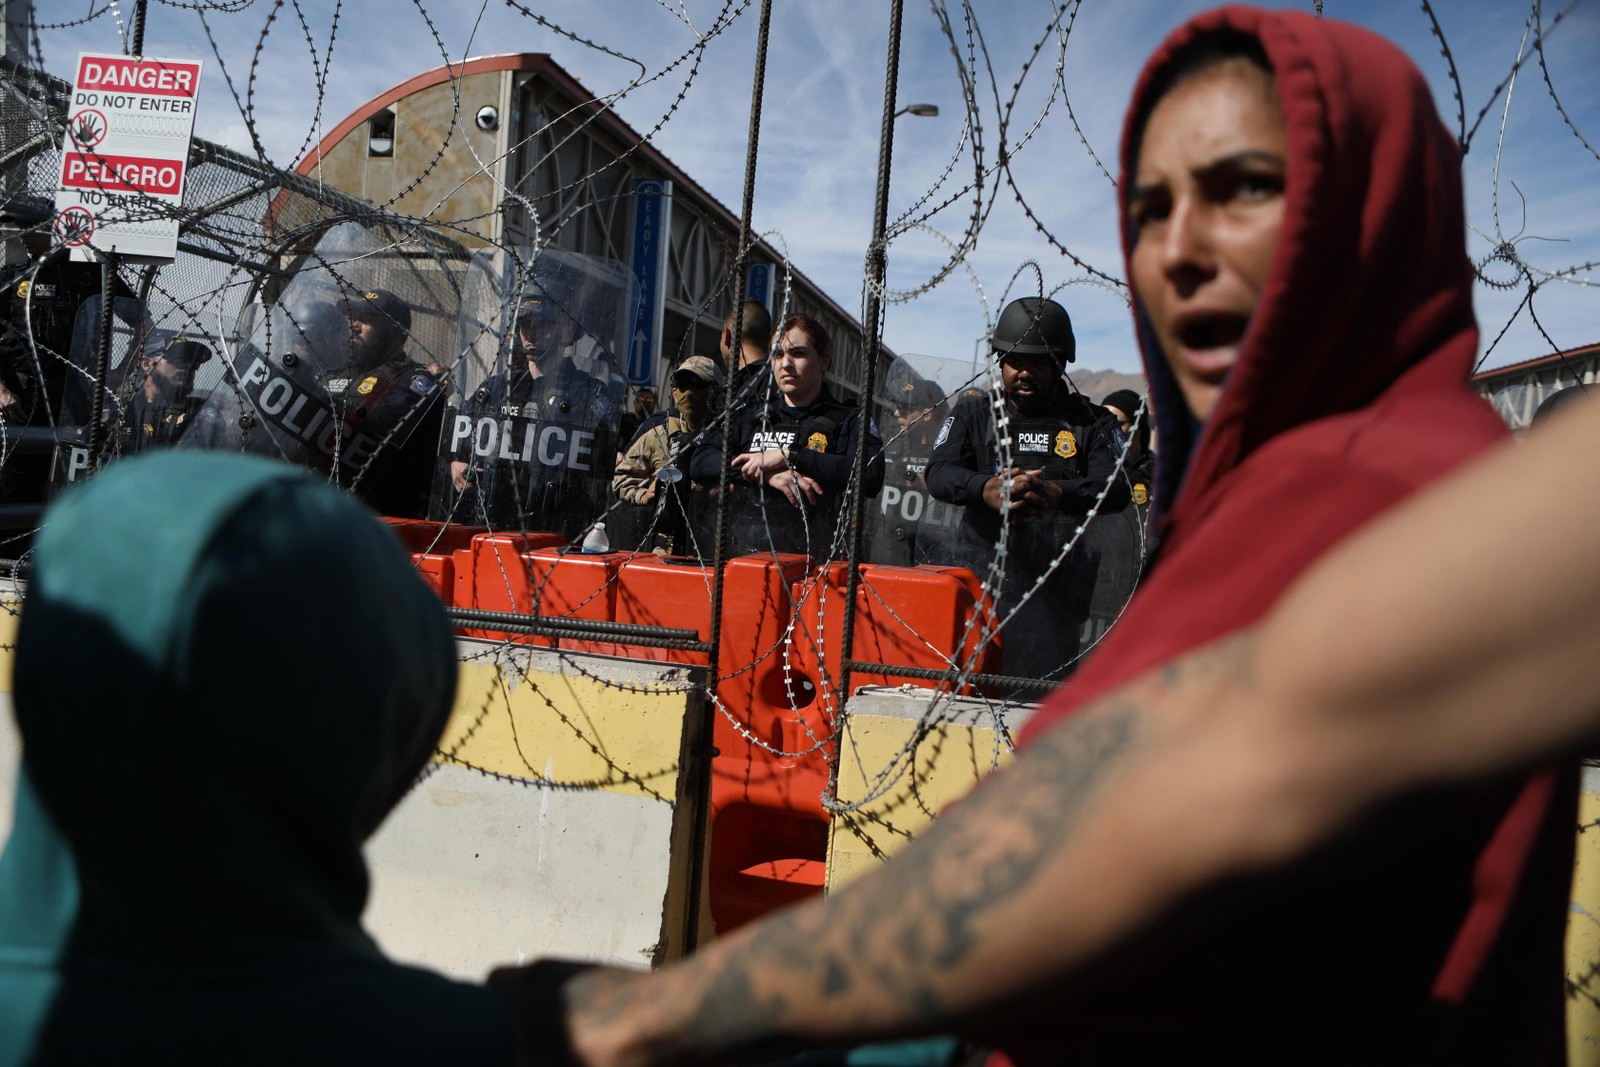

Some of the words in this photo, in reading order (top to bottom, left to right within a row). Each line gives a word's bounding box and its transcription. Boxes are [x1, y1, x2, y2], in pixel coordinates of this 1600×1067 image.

[83, 63, 192, 91] DANGER
[75, 93, 99, 107] DO
[103, 95, 137, 110] NOT
[140, 97, 193, 114] ENTER
[68, 160, 177, 189] PELIGRO
[80, 191, 103, 206] NO
[643, 186, 654, 256] READY
[35, 284, 56, 292] POLICE
[638, 267, 648, 320] LANE
[239, 356, 377, 470] POLICE
[450, 415, 595, 472] POLICE
[752, 432, 796, 444] POLICE
[1018, 433, 1049, 444] POLICE
